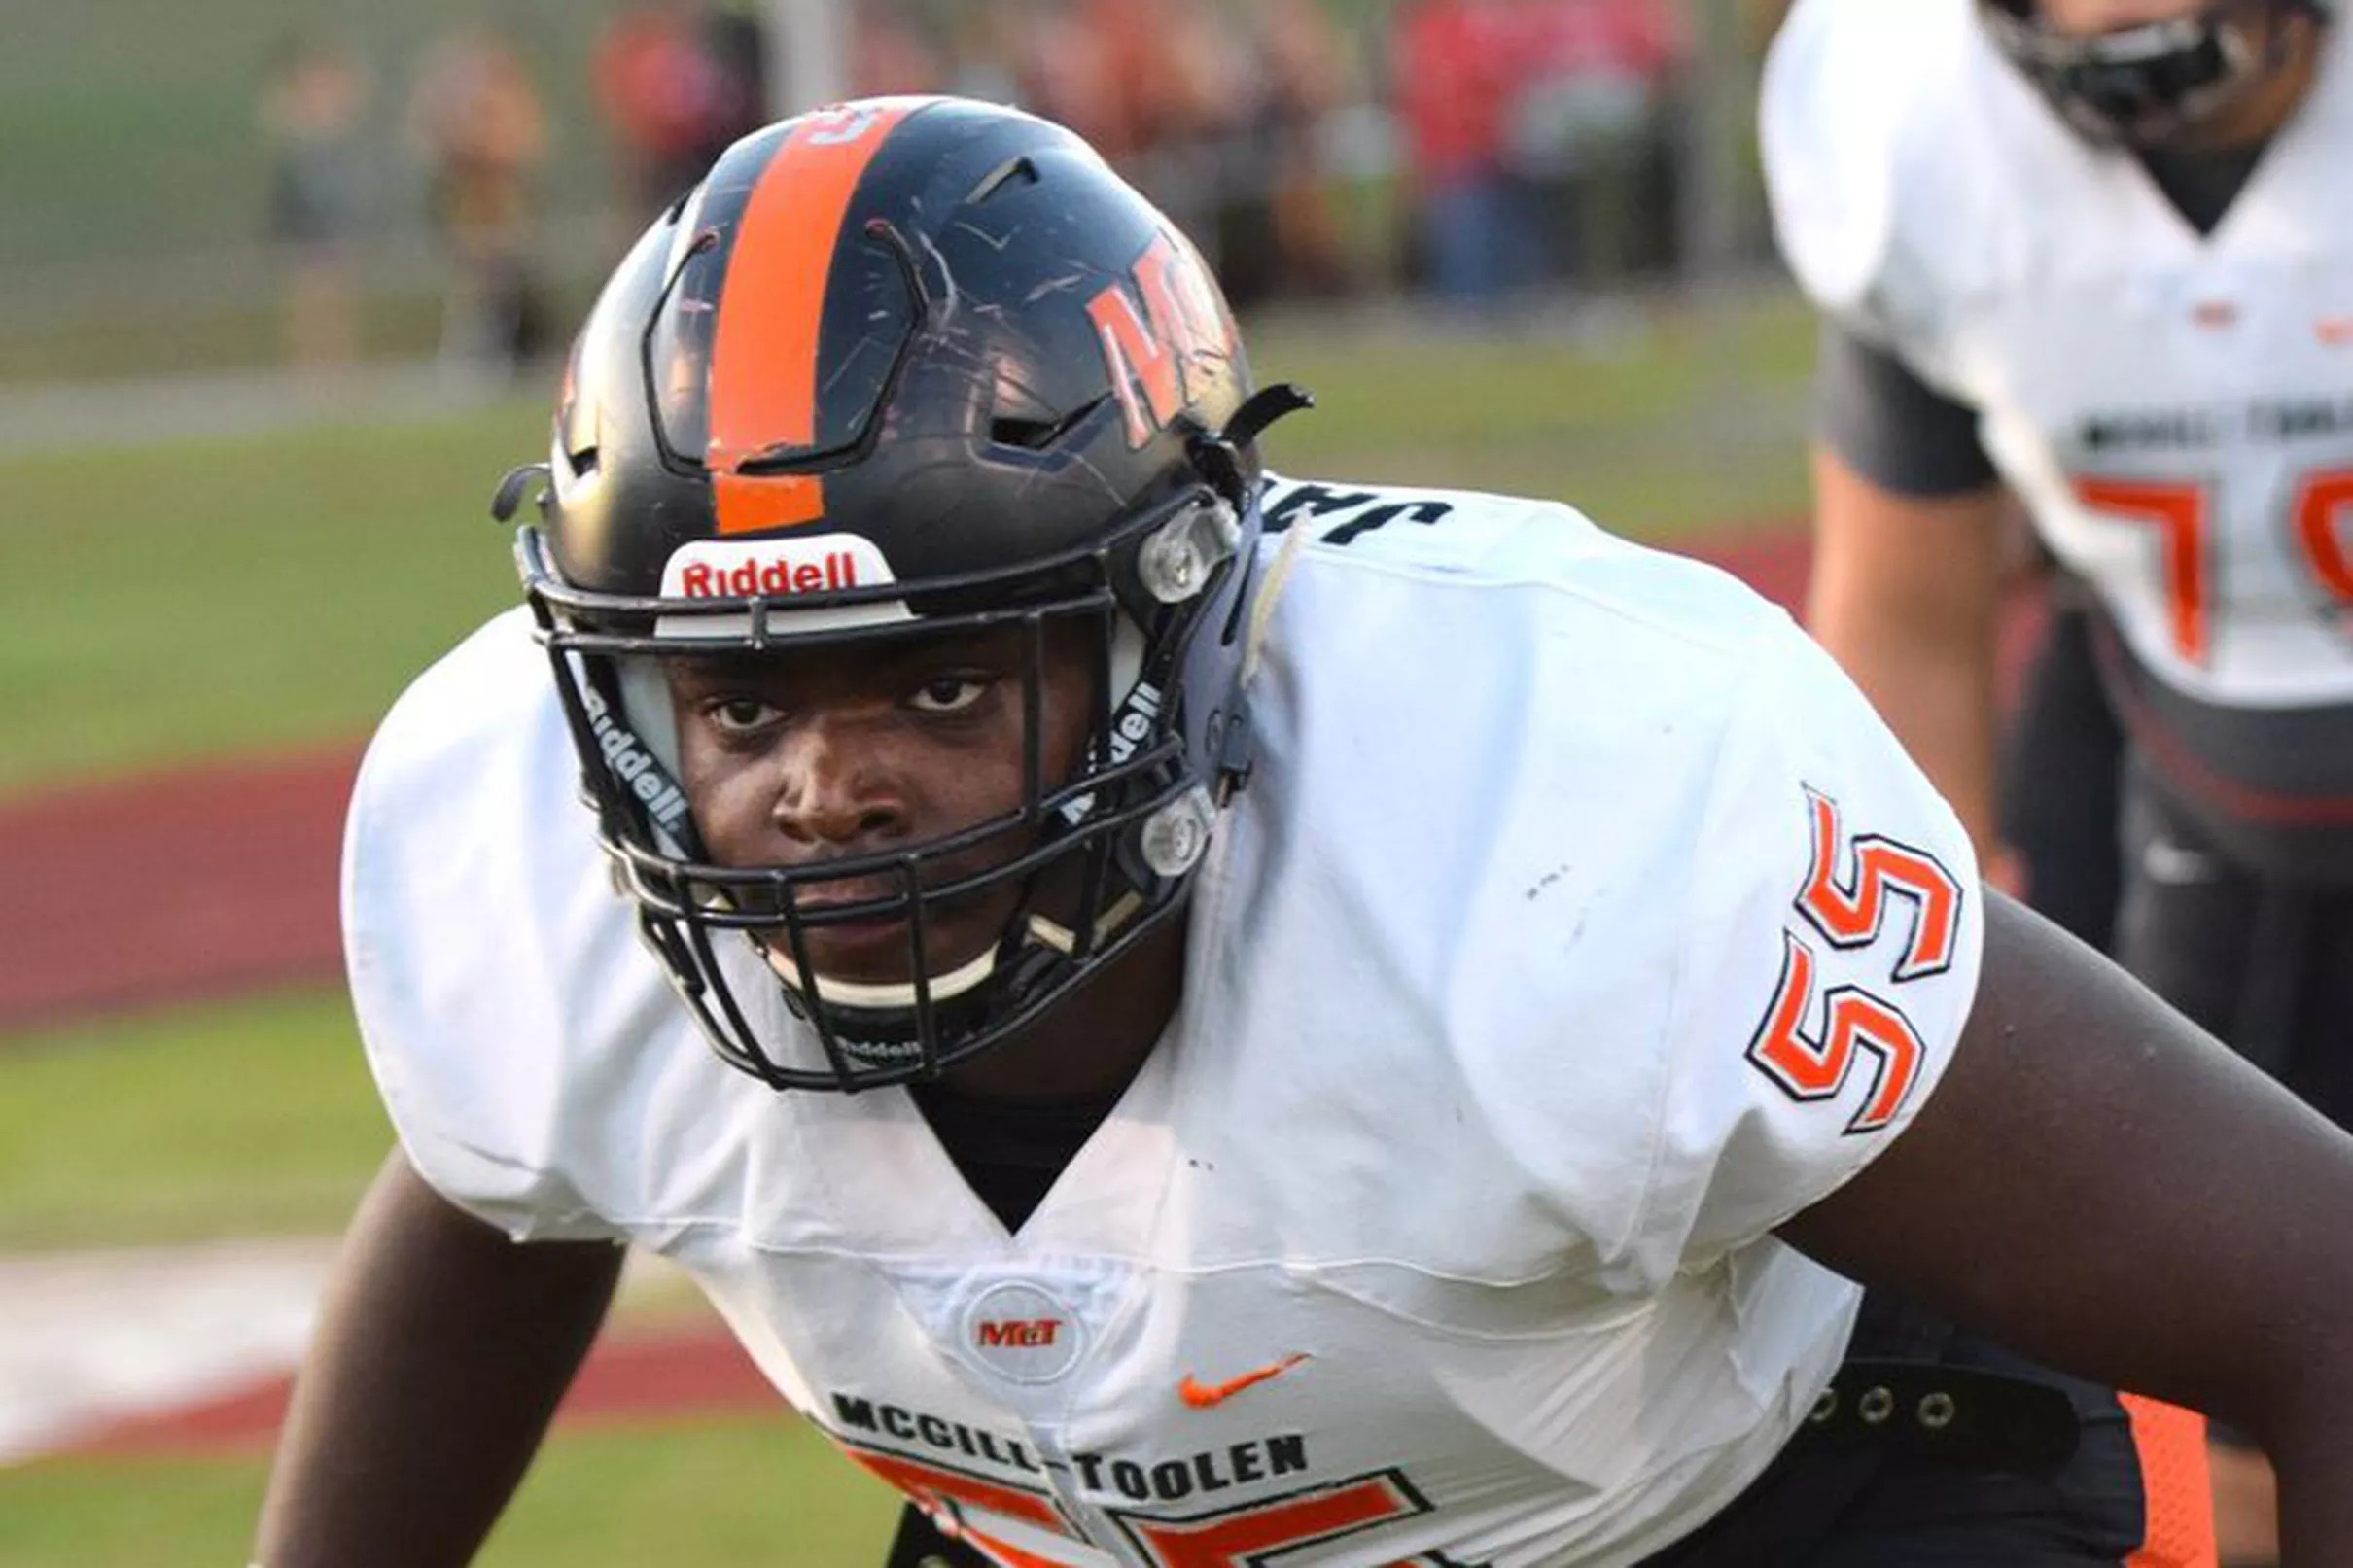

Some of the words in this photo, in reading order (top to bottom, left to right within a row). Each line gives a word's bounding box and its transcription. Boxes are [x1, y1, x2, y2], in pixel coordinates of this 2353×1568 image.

[682, 551, 857, 597] Riddell
[1743, 781, 1964, 1135] 55
[831, 1392, 1309, 1501] MCGILL-TOOLEN
